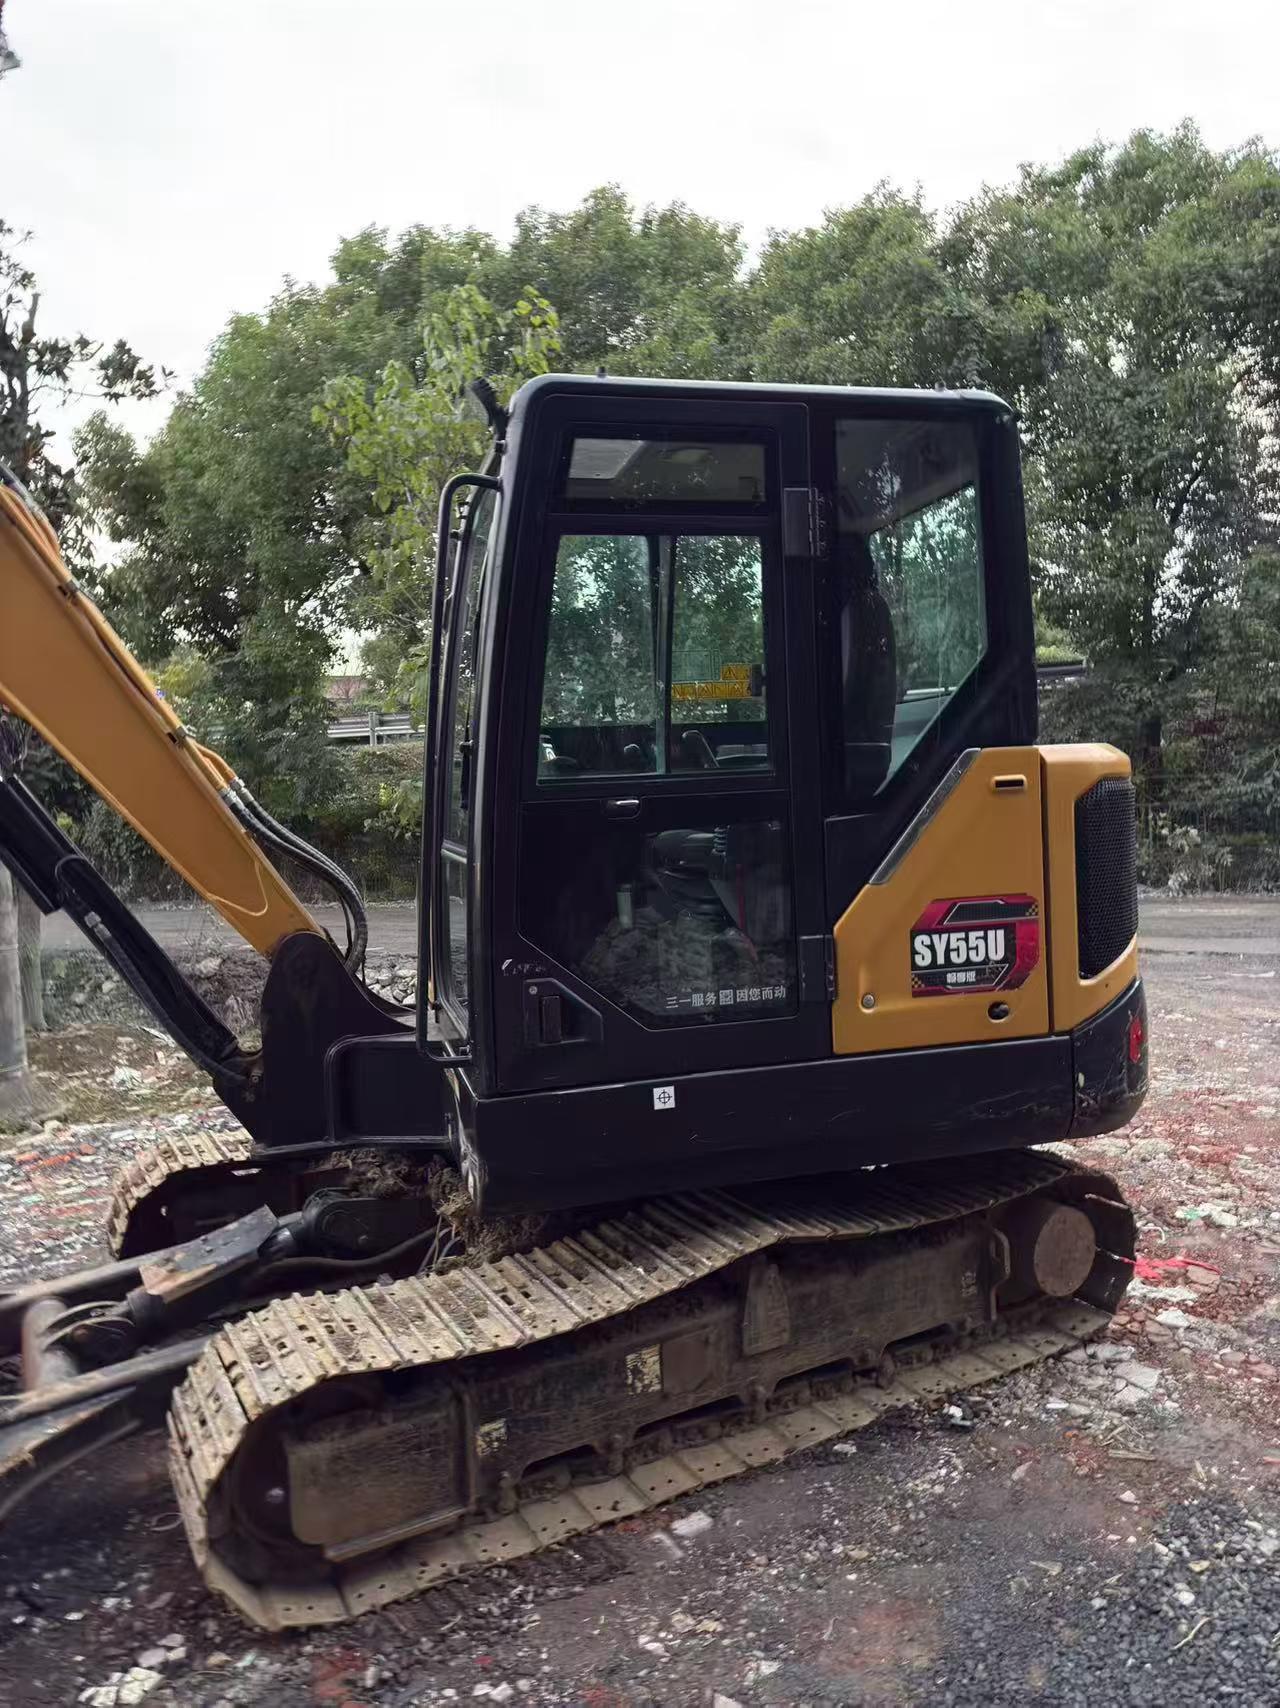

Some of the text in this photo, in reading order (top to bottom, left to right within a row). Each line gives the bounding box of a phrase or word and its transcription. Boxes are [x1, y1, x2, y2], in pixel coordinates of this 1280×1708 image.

[913, 929, 1005, 967] SY55U
[665, 985, 786, 1008] 三一服务 因您而动
